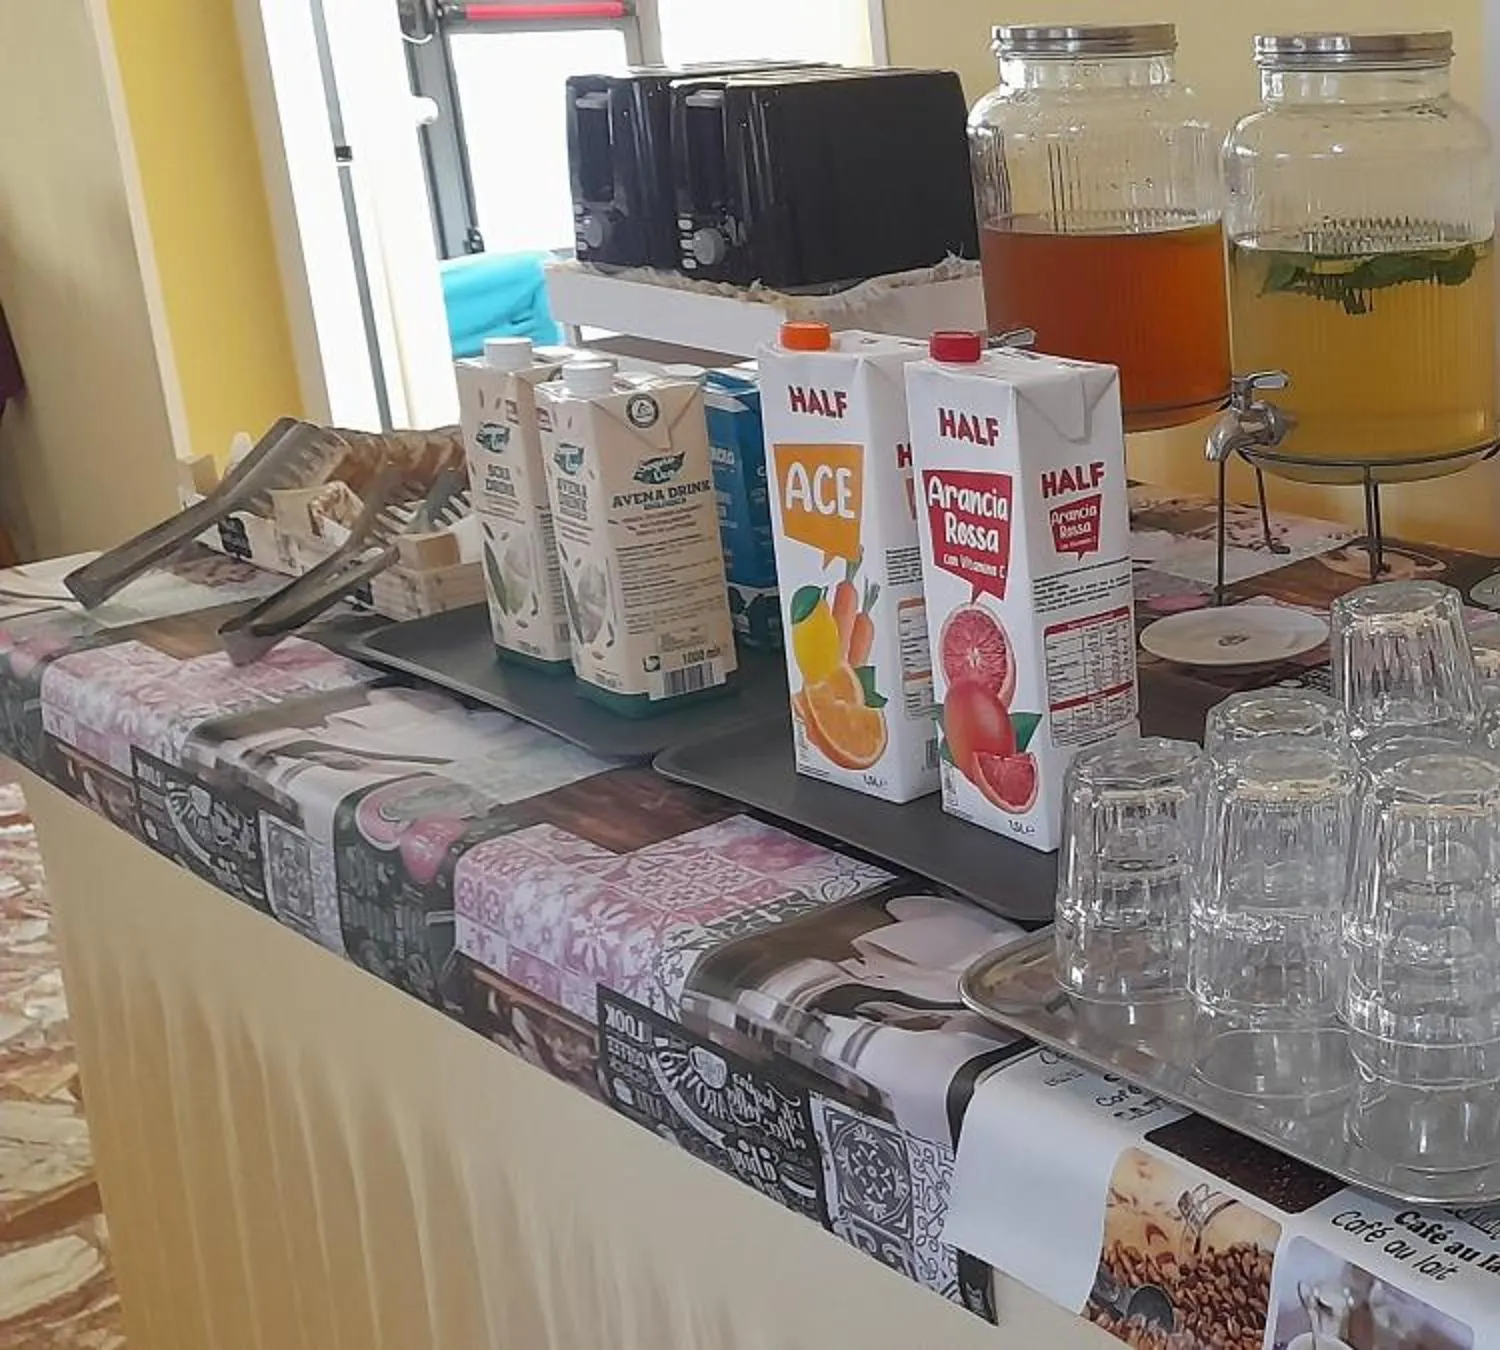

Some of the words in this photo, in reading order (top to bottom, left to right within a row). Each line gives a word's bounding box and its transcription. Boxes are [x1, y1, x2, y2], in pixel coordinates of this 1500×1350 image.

[788, 385, 847, 418] HALF
[938, 407, 999, 446] HALF
[612, 489, 665, 507] AVENA
[667, 479, 711, 498] DRINK
[785, 461, 855, 519] ACE
[928, 475, 1009, 521] Arancia
[1041, 461, 1105, 498] HALF
[943, 510, 1000, 554] Rossa
[1051, 503, 1097, 526] Arancia
[1059, 521, 1092, 539] Rossa
[1331, 1210, 1394, 1243] Café
[1383, 1239, 1417, 1260] au
[1411, 1253, 1460, 1281] lait
[1394, 1210, 1454, 1245] Café
[1443, 1241, 1481, 1263] au
